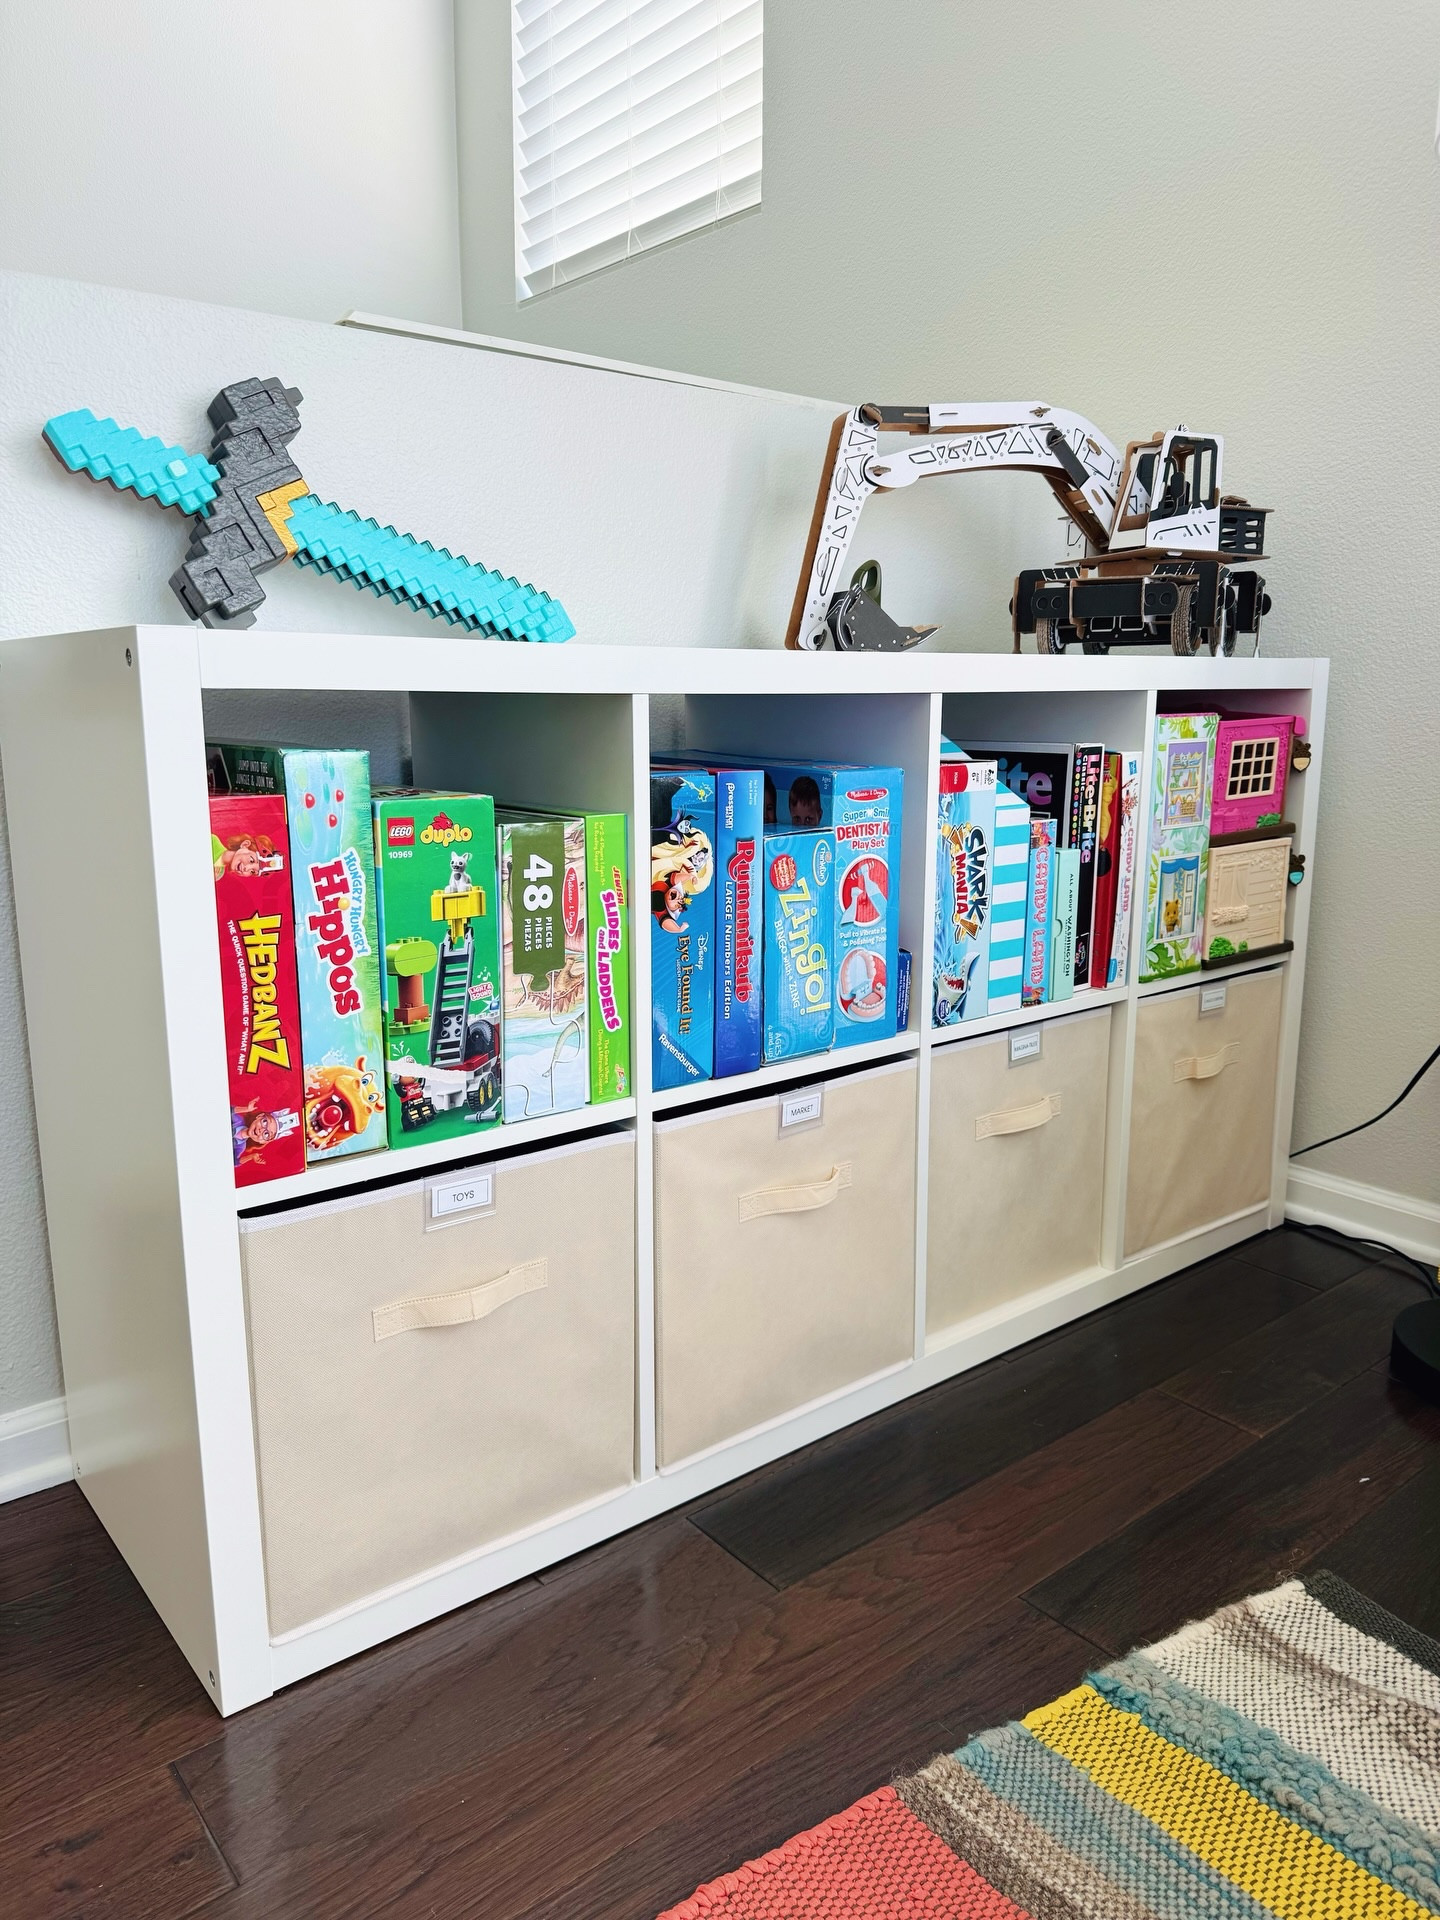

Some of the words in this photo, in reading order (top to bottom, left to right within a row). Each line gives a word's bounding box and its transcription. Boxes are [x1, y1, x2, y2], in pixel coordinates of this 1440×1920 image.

[260, 761, 268, 774] THE
[266, 776, 274, 789] THE
[389, 825, 413, 839] LEGO
[836, 822, 881, 842] DENTIST
[843, 809, 867, 822] Super
[420, 823, 473, 848] duplo
[852, 840, 870, 851] Play
[870, 838, 885, 848] Set
[1125, 827, 1134, 874] CANDY
[388, 850, 413, 860] 10969
[344, 851, 363, 904] HUNGRY
[523, 853, 554, 912] 48
[612, 866, 625, 905] JEWISH
[955, 852, 969, 915] MANIA
[965, 827, 989, 926] SHARK
[1033, 847, 1050, 924] CANDY
[724, 881, 733, 920] LARGE
[1122, 877, 1131, 912] LAND
[227, 919, 237, 935] THE
[308, 860, 362, 1016] Hippos
[349, 905, 369, 955] HUNGRY
[524, 918, 532, 952] PIEZAS
[535, 917, 543, 950] PIÈCES
[545, 916, 553, 949] PIECES
[602, 891, 620, 951] SLIDES
[728, 839, 756, 1003] Rummikub
[231, 935, 243, 958] QUICK
[598, 929, 606, 950] and
[676, 935, 692, 962] Eye
[695, 931, 709, 971] Disney
[724, 924, 733, 976] Numbers
[774, 919, 788, 955] BINGO
[783, 956, 792, 976] with
[778, 877, 831, 1016] Zingo!
[1030, 929, 1046, 985] LAND
[1065, 915, 1073, 977] WASHINGTON
[237, 958, 248, 994] QUESTION
[237, 909, 292, 1075] HEDBANZ
[597, 951, 620, 1030] LADDERS
[680, 964, 694, 1015] Found
[242, 994, 250, 1016] GAME
[724, 979, 733, 1020] Edition
[242, 1016, 249, 1026] OF
[678, 1017, 692, 1035] It!
[238, 1053, 246, 1065] AM
[658, 1033, 700, 1077] Ravensburger
[767, 1049, 774, 1058] up
[774, 1032, 782, 1057] AGES
[791, 1104, 813, 1117] MARKET
[452, 1190, 475, 1203] TOYS
